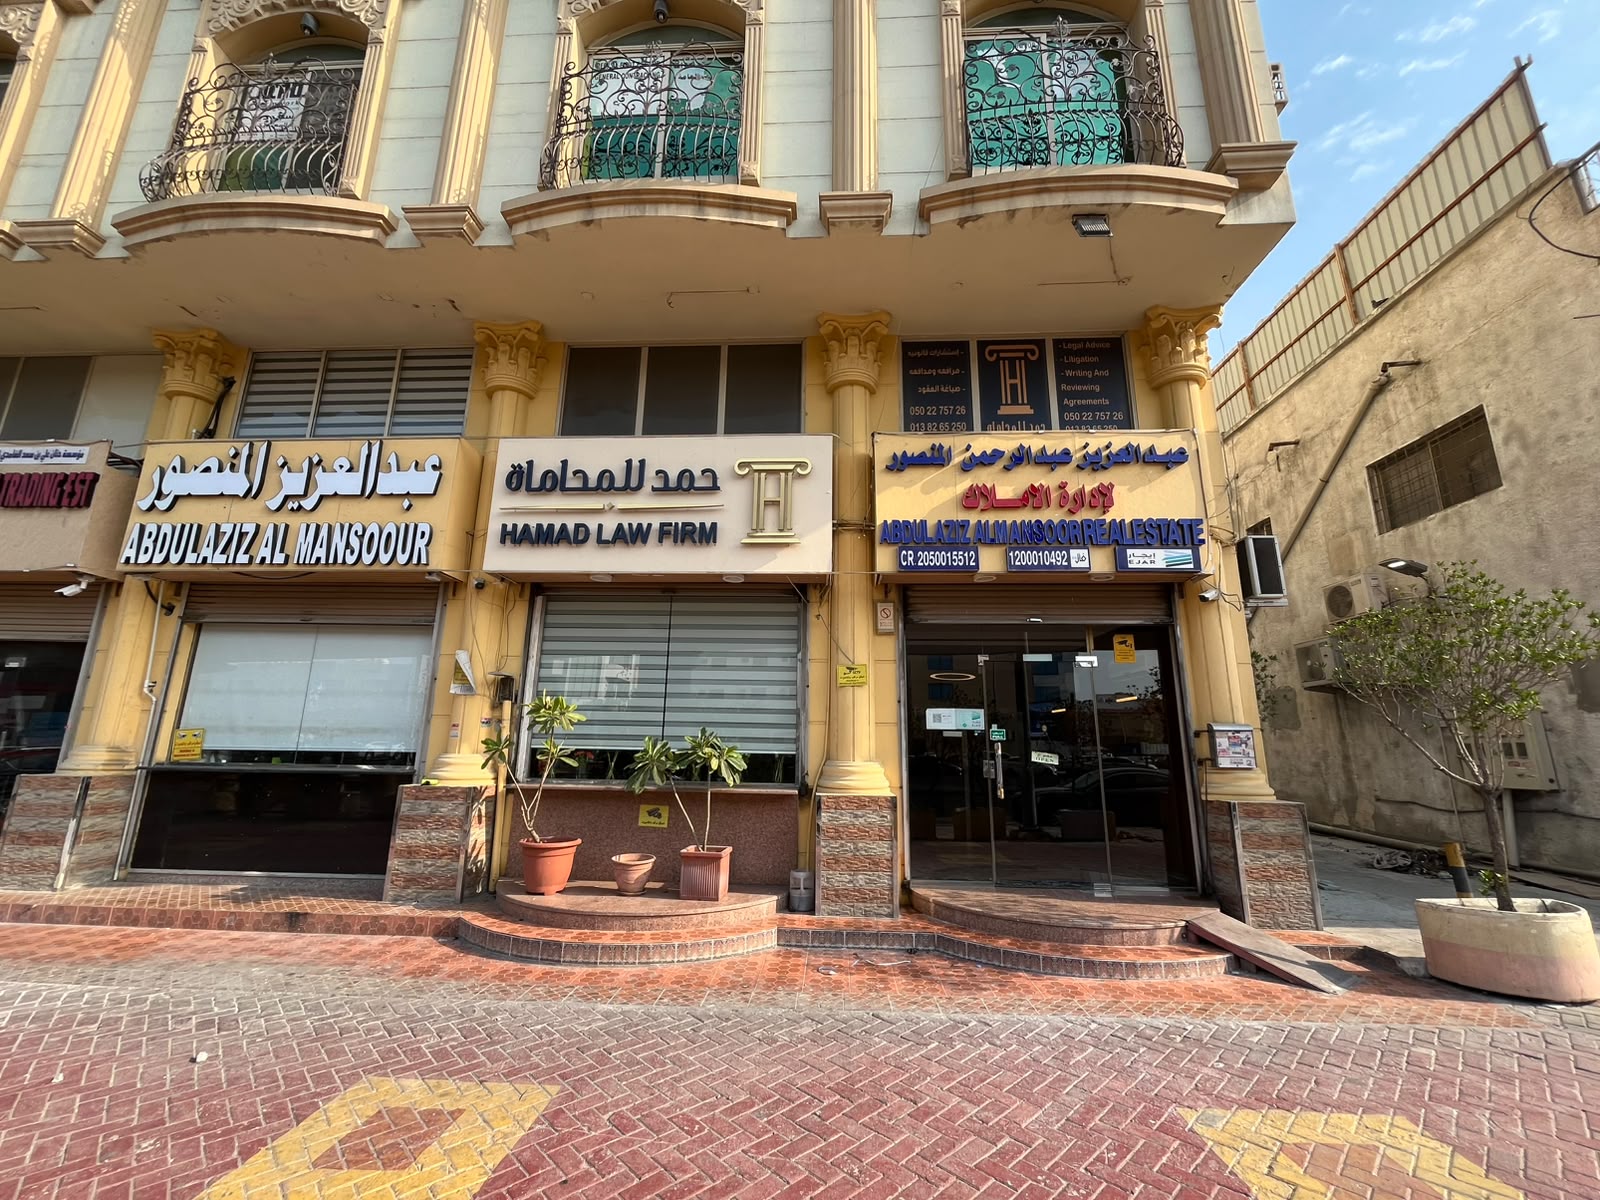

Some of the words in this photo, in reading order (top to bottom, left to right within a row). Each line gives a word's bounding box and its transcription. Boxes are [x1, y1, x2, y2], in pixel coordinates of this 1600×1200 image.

[1063, 342, 1084, 350] Legal
[1085, 341, 1111, 349] Advice
[1064, 355, 1099, 364] Litigation
[1065, 369, 1093, 378] Writing
[1061, 383, 1100, 392] Reviewing
[1063, 398, 1110, 407] Agreements
[909, 406, 925, 415] 050
[926, 406, 937, 415] 22
[939, 406, 954, 415] 757
[955, 405, 967, 415] 26
[1064, 412, 1080, 421] 050
[1082, 412, 1093, 420] 22
[1095, 411, 1111, 420] 757
[1112, 411, 1124, 420] 26
[910, 422, 925, 431] 013
[927, 422, 938, 431] 82
[939, 422, 950, 431] 65
[952, 422, 967, 431] 250
[886, 443, 952, 471] المنصور
[137, 440, 271, 511] المنصور
[505, 458, 646, 492] للمحاماة
[651, 467, 721, 492] حمد
[61, 472, 97, 507] EST
[500, 522, 590, 545] HAMAD
[596, 522, 653, 545] LAW
[658, 521, 718, 544] FIRM
[120, 523, 259, 564] ABDULAZIZ
[255, 522, 288, 564] AL
[294, 521, 432, 565] MANSOOUR
[1009, 550, 1069, 566] 1200010492
